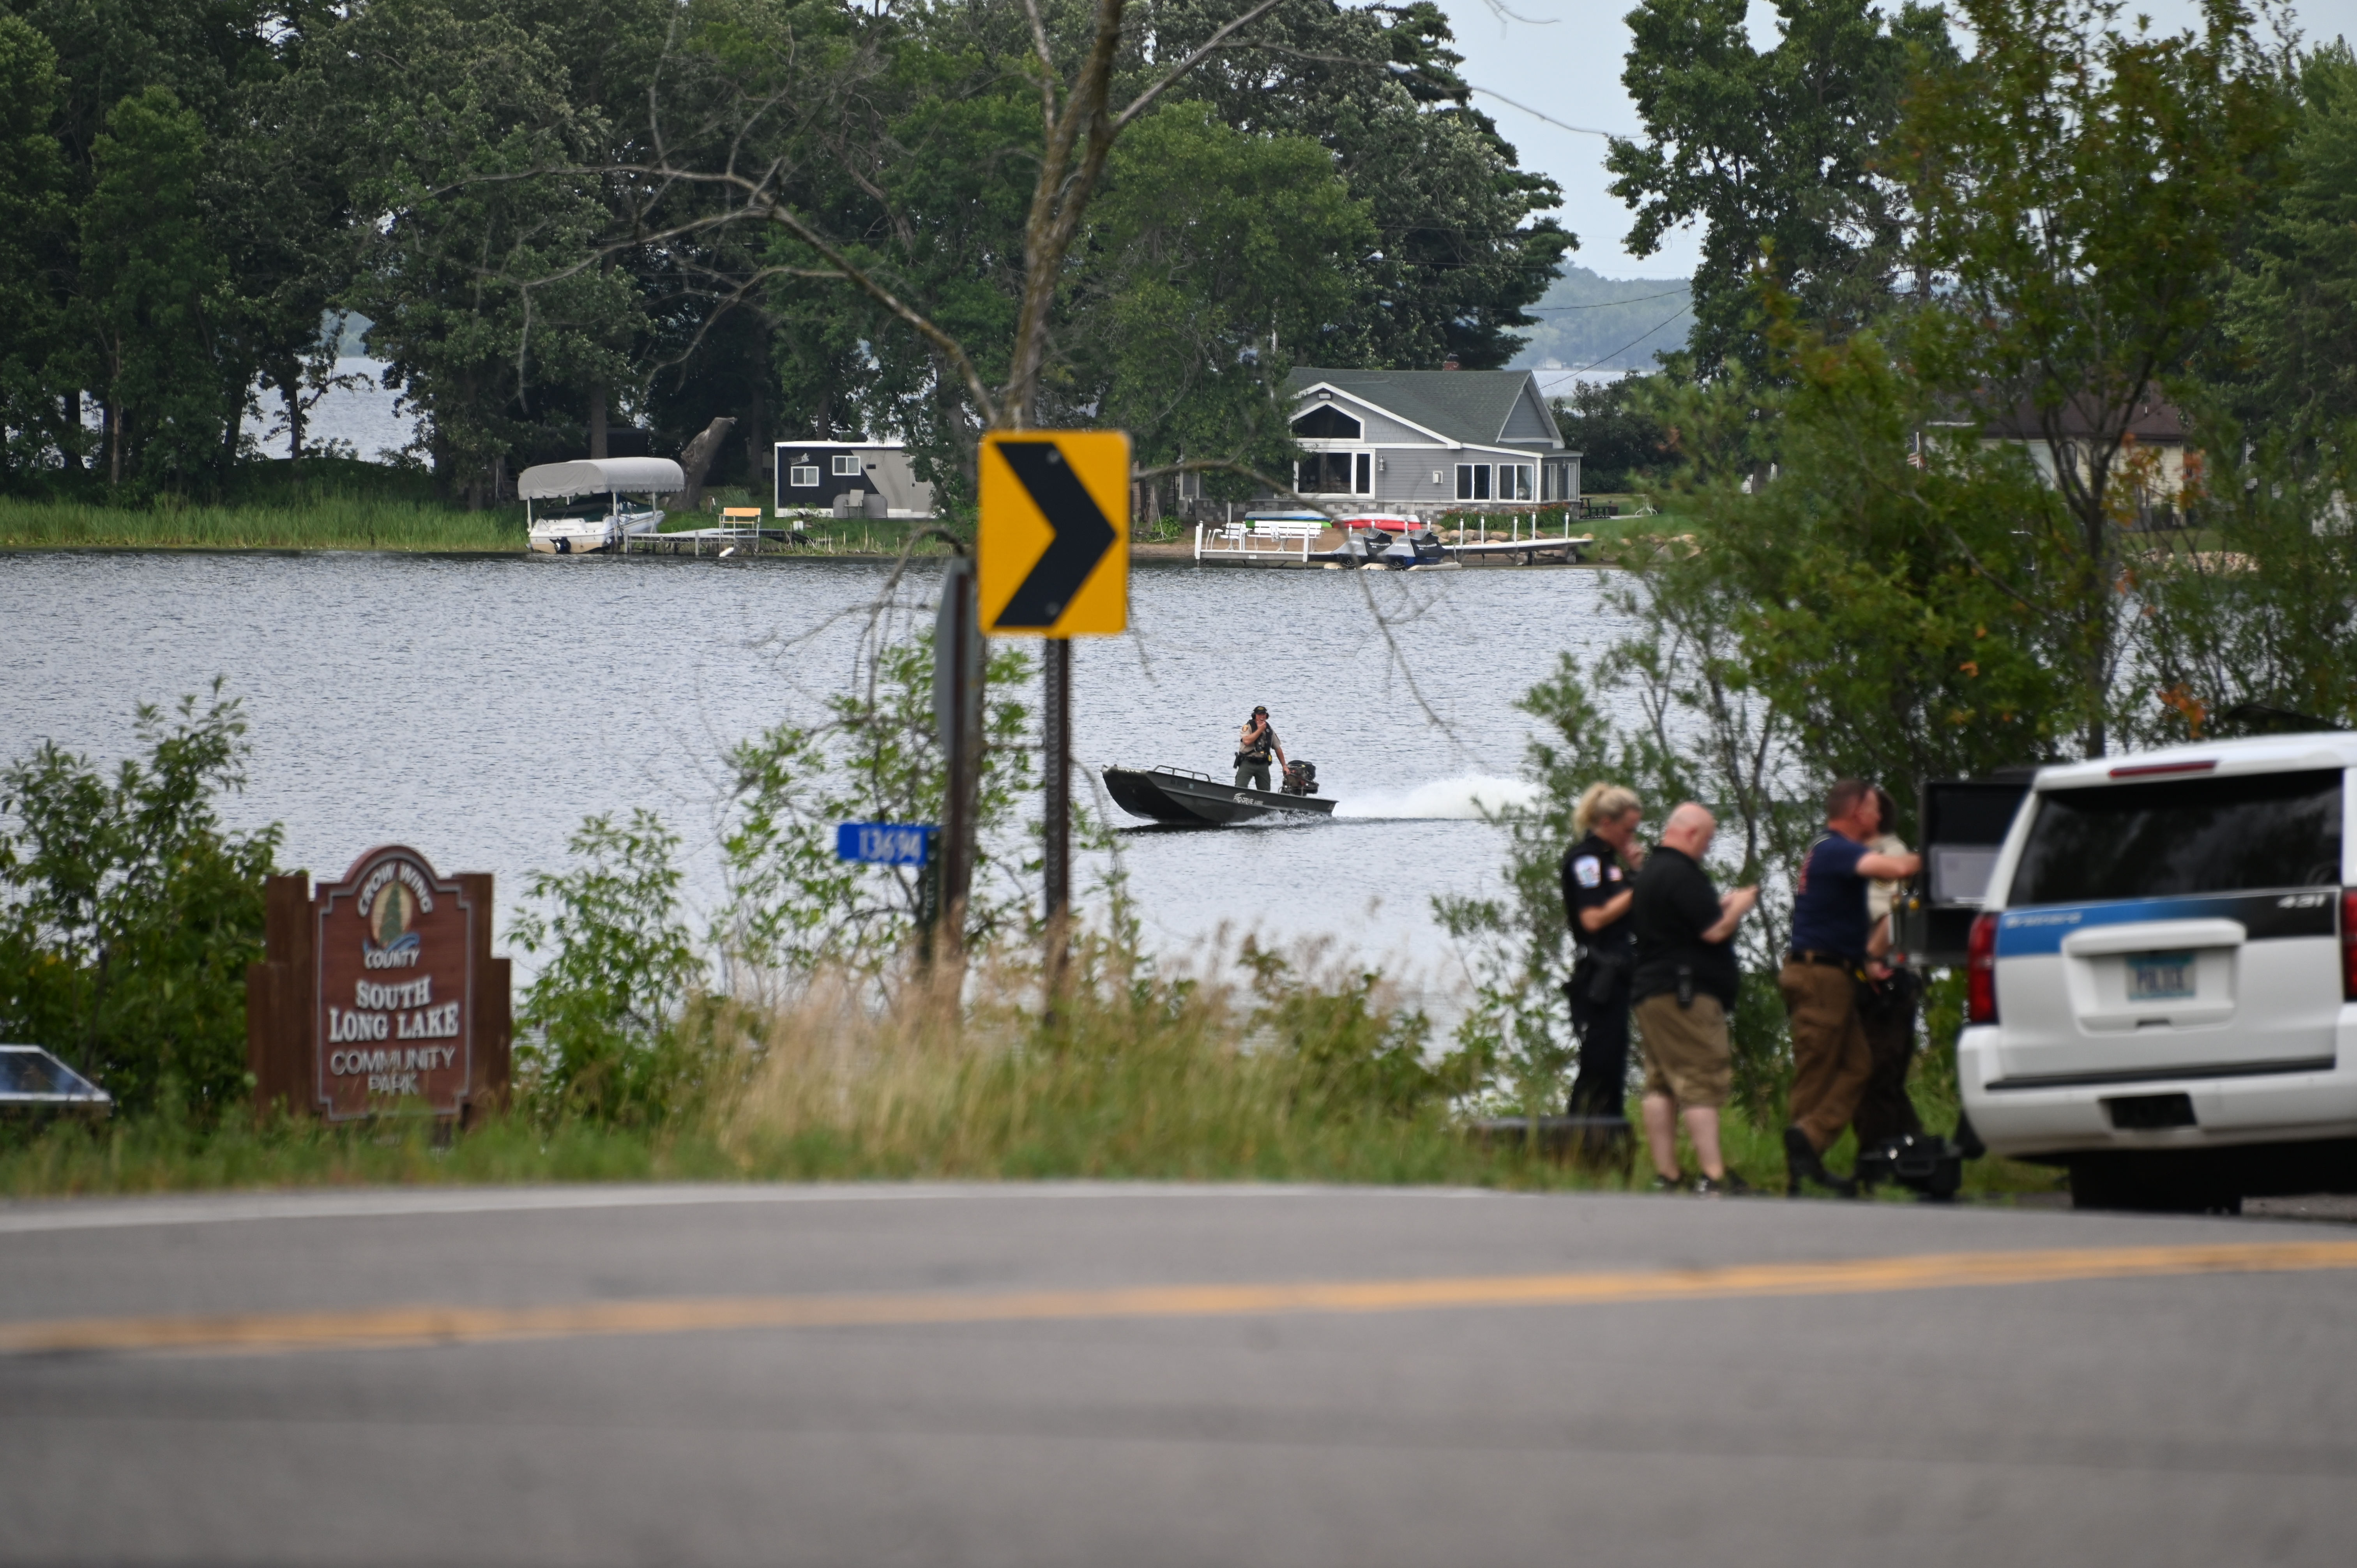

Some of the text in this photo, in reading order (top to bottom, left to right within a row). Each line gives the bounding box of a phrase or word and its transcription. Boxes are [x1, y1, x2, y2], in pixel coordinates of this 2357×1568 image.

[859, 829, 921, 861] 13694
[359, 863, 433, 916] CROW WING
[366, 950, 420, 969] COUNTY
[356, 977, 431, 1010] SOUTH
[329, 1001, 458, 1043] LONG LAKE
[331, 1047, 455, 1075] COMMUNITY
[368, 1073, 419, 1097] PARK
